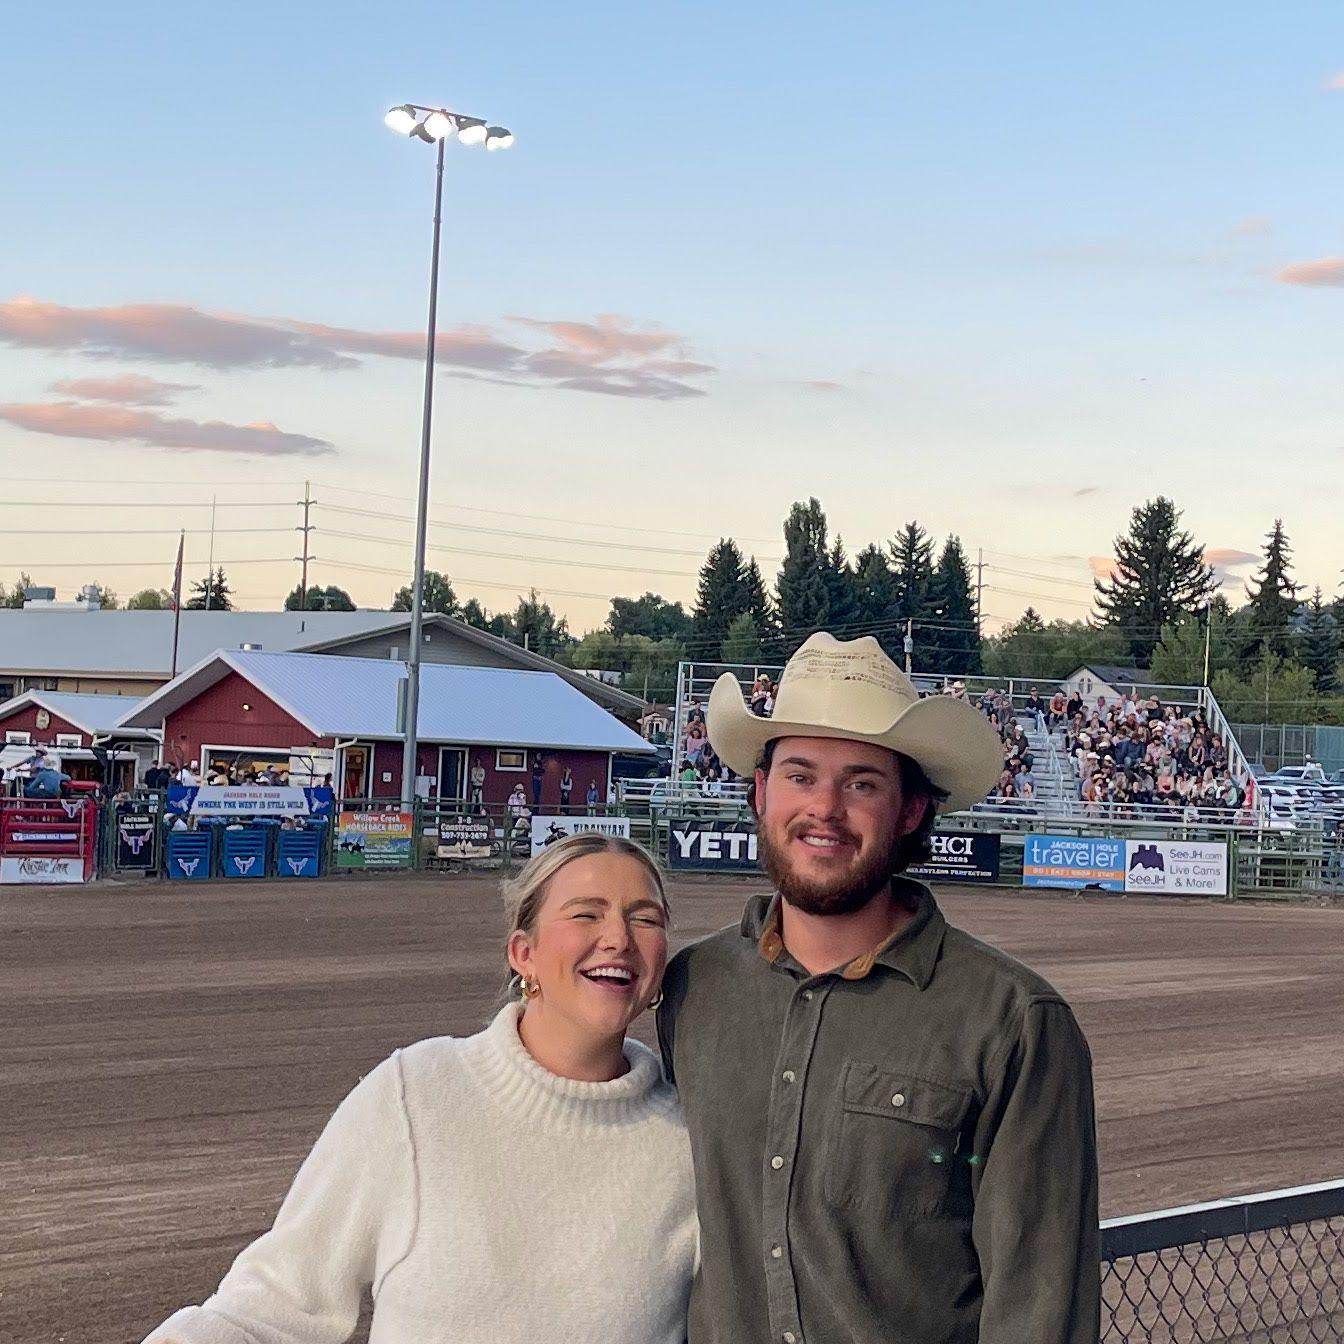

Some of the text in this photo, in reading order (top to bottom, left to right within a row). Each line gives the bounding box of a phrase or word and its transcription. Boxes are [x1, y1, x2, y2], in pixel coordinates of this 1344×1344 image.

[198, 801, 222, 809] WHERE
[224, 801, 236, 809] THE
[239, 801, 258, 809] WEST
[267, 801, 285, 809] STILL
[353, 813, 400, 823] Willow Creek
[440, 823, 489, 832] Construction
[672, 830, 758, 860] YETI
[929, 836, 974, 855] HCI
[1050, 841, 1119, 852] JACKSON HOLE
[1031, 840, 1119, 867] traveler
[1169, 865, 1221, 876] Live Cams
[1128, 873, 1165, 885] SeeJH
[1174, 878, 1217, 889] & More!
